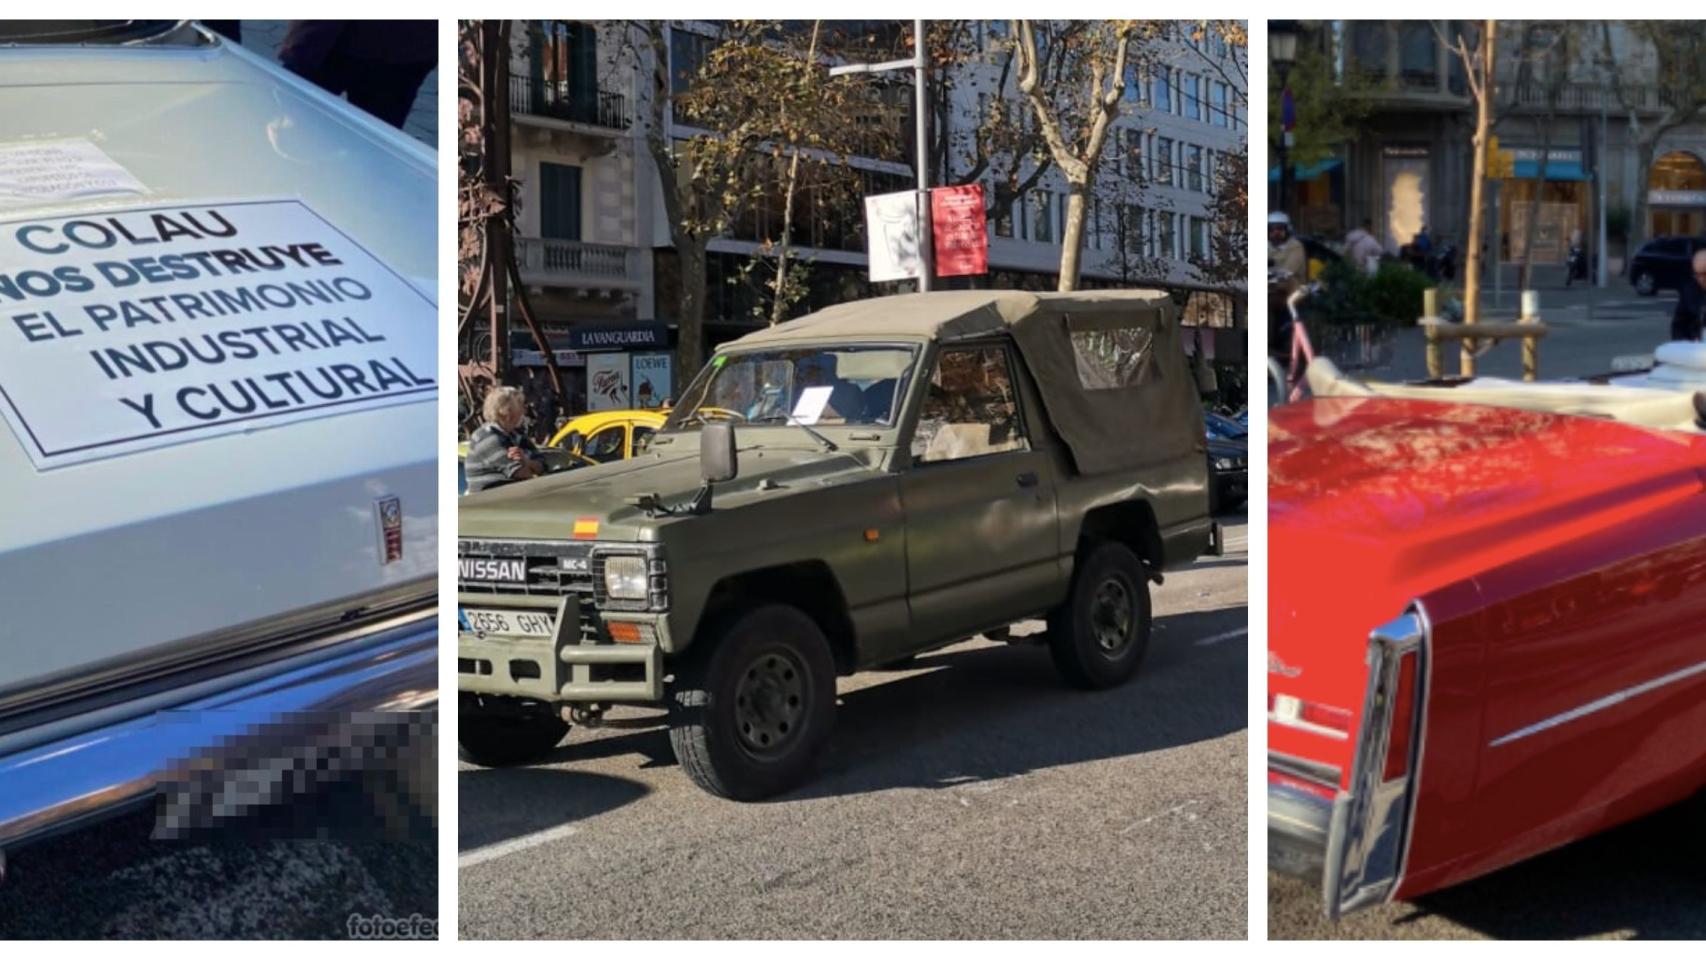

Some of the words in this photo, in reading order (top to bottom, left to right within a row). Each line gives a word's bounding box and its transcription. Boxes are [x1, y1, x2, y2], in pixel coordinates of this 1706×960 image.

[15, 210, 238, 255] COLAU
[0, 266, 95, 301] NOS
[94, 242, 343, 288] DESTRUYE
[12, 311, 84, 342] EL
[83, 276, 372, 331] PATRIMONIO
[90, 316, 386, 379] INDUSTRIAL
[582, 333, 594, 345] LA
[593, 330, 655, 344] VANGUARDIA
[635, 357, 668, 369] LOEWE
[119, 393, 163, 429] Y
[176, 357, 435, 420] CULTURAL
[458, 560, 526, 580] NISSAN
[563, 560, 587, 569] MC-4
[467, 612, 510, 632] 2656
[516, 613, 552, 633] GHY
